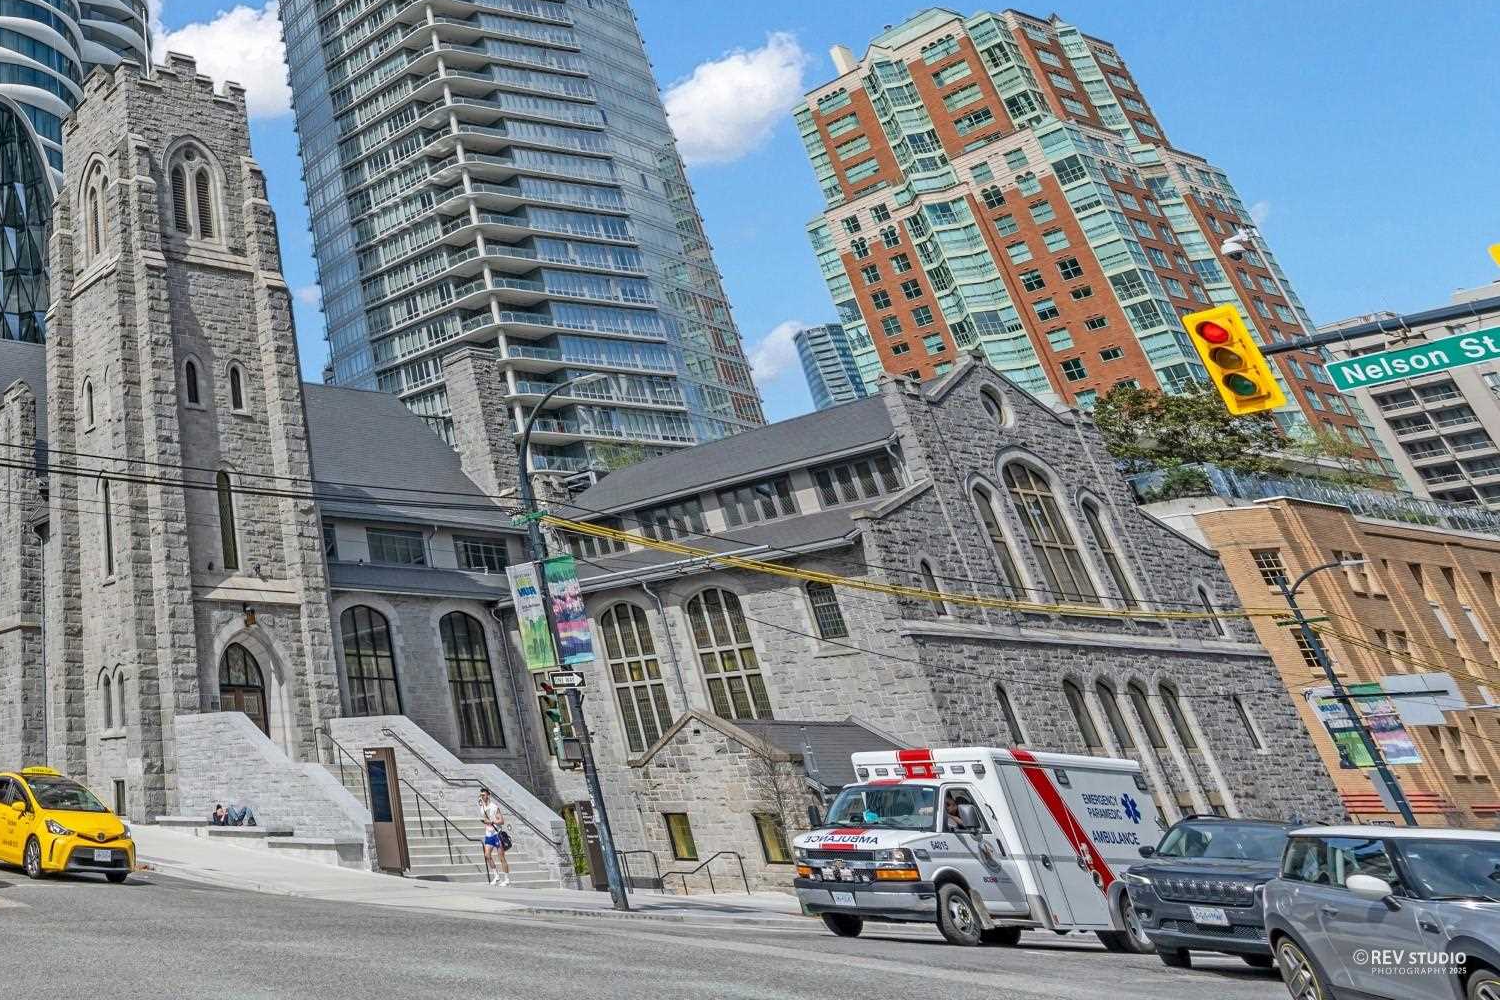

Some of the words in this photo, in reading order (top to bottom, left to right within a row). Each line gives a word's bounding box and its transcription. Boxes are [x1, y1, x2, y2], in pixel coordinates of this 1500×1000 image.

[1340, 349, 1450, 385] Nelson
[1459, 334, 1500, 359] St
[1081, 793, 1118, 806] EMERGENCY
[1087, 807, 1122, 820] PARAMEDIC
[1092, 831, 1140, 845] AMBULANCE
